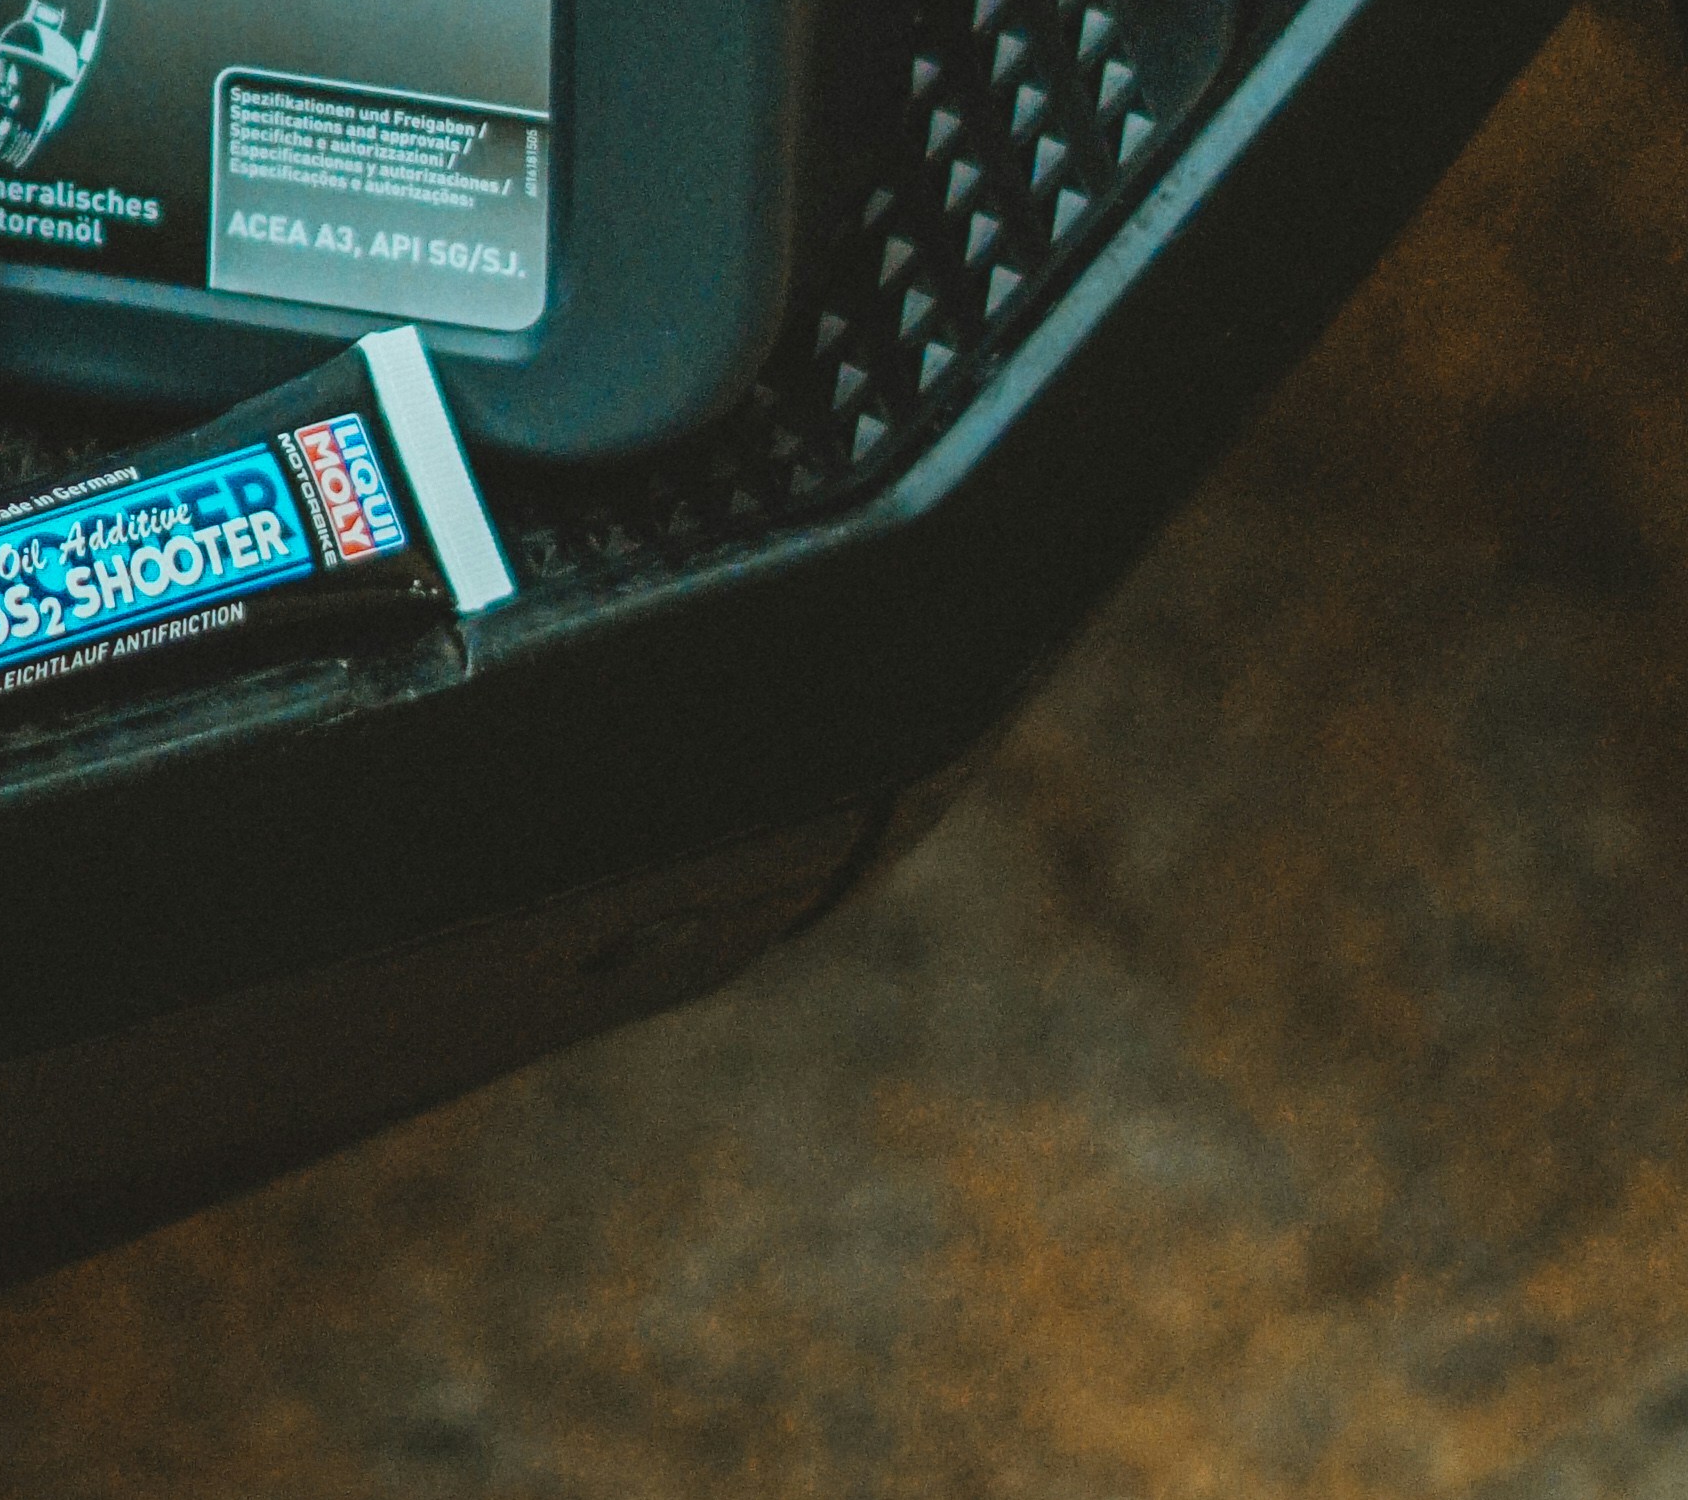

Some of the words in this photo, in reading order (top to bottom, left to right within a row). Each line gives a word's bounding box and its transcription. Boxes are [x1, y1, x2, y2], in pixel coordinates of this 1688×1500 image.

[230, 87, 355, 119] Spezifikationen
[358, 108, 391, 125] und
[393, 110, 476, 137] Freigaben
[230, 104, 343, 135] Specifications
[345, 124, 377, 140] and
[379, 129, 461, 153] approvals
[230, 121, 313, 148] Specifiche
[330, 139, 444, 168] autorizzazioni
[230, 140, 363, 174] Especificaciones
[379, 164, 500, 194] autorizaciones
[227, 210, 309, 247] ACEA
[314, 222, 362, 259] A3,
[369, 230, 421, 263] API
[427, 239, 528, 279] SG/SJ.
[33, 492, 55, 510] in
[52, 465, 139, 502] Germany
[277, 432, 338, 567] MOTORBIKE
[302, 429, 373, 547] MOLY
[333, 422, 399, 542] LIQUI
[59, 501, 193, 567] Additive
[65, 509, 290, 619] SHOOTER
[112, 600, 246, 656] ANTIFRICTION
